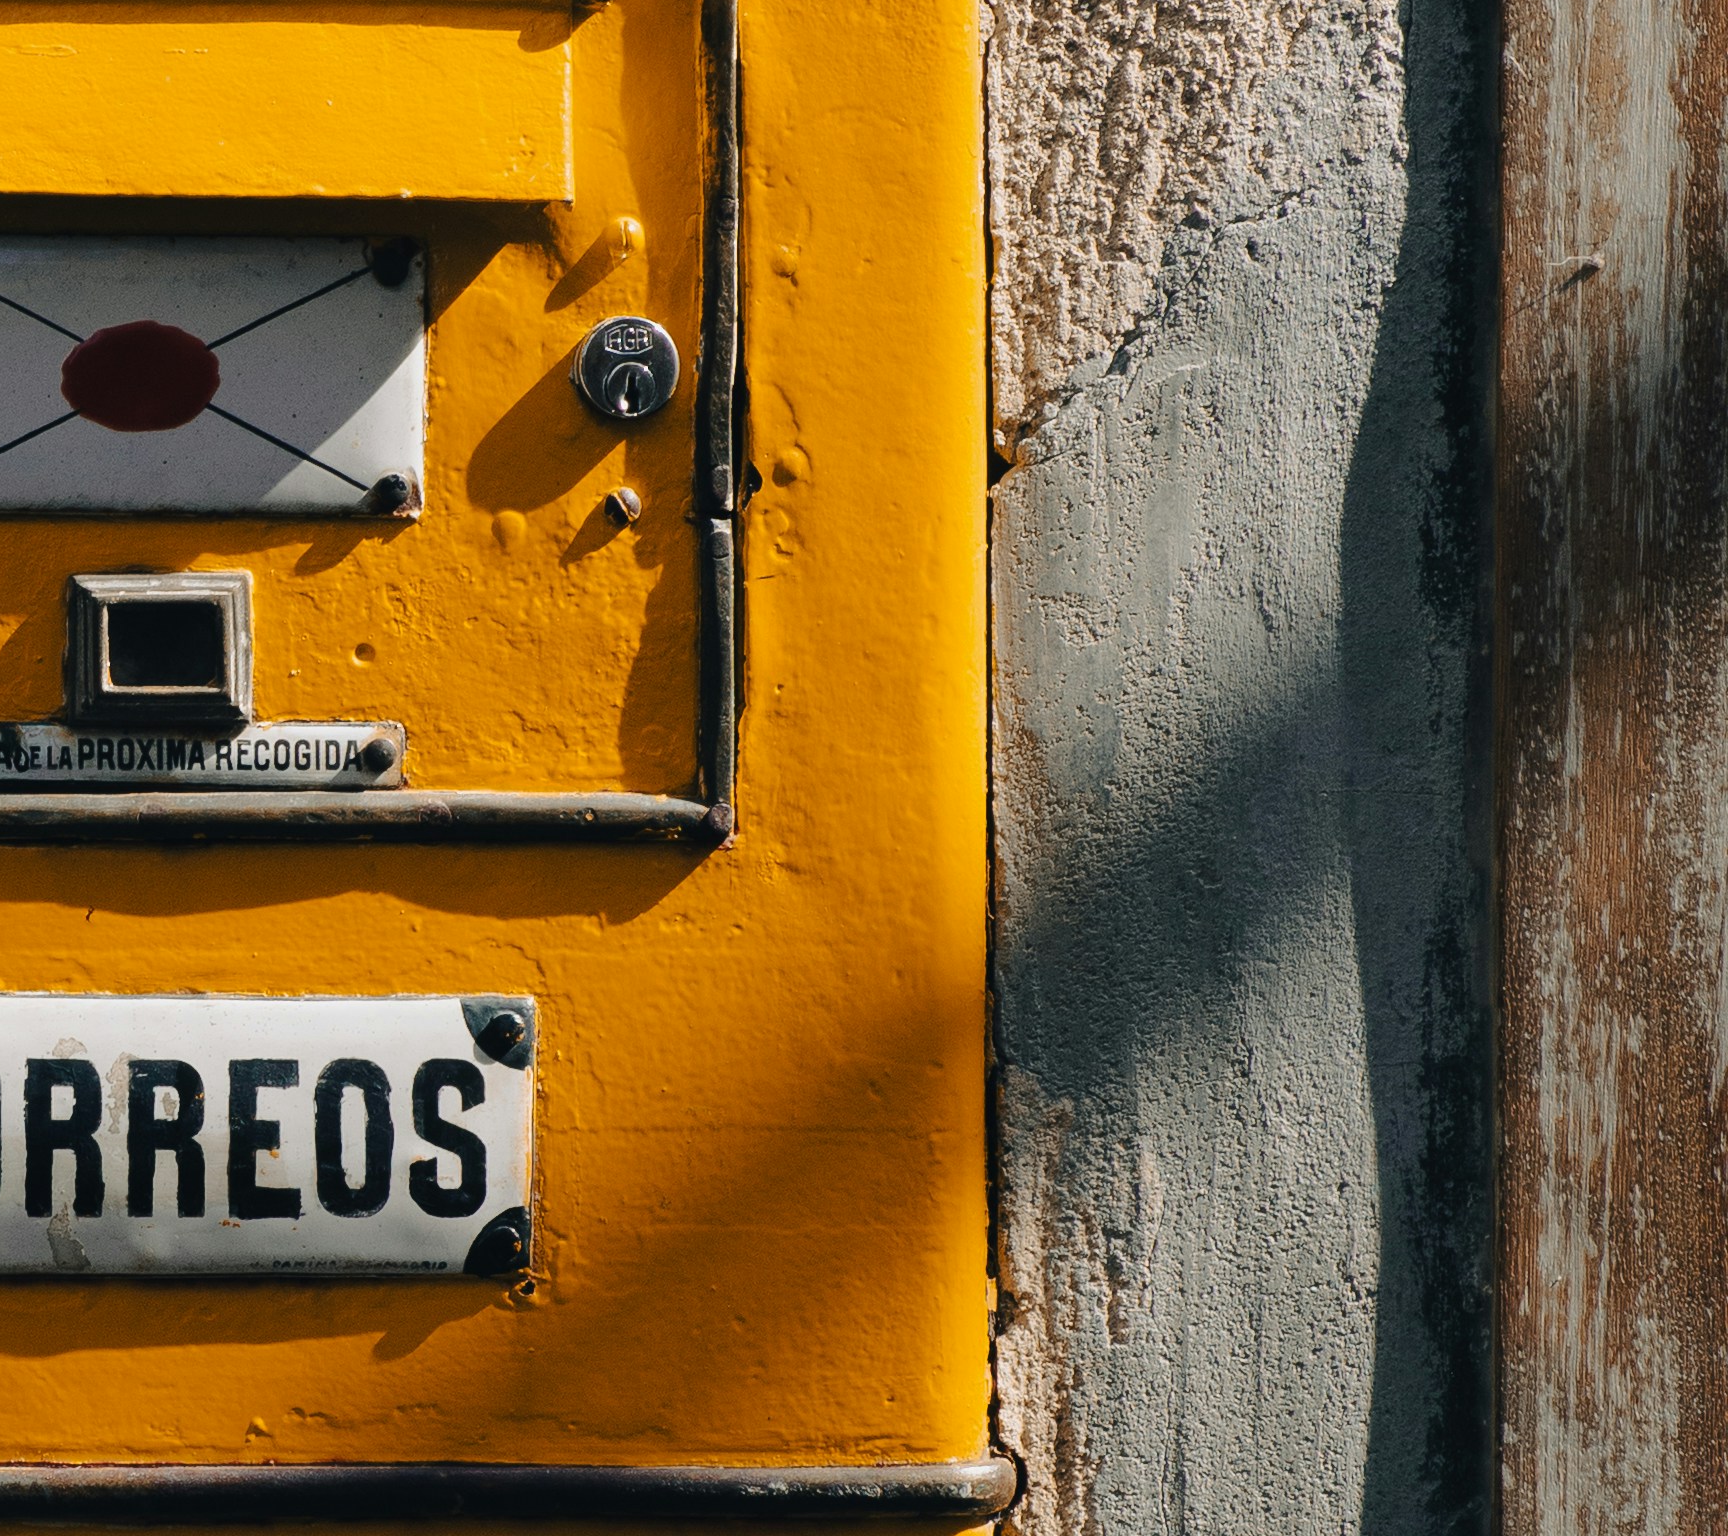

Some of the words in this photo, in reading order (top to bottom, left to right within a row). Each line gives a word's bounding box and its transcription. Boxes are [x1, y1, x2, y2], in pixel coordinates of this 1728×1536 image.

[46, 745, 72, 770] LA
[77, 738, 206, 770] PROXIMA
[215, 739, 363, 772] RECOGIDA
